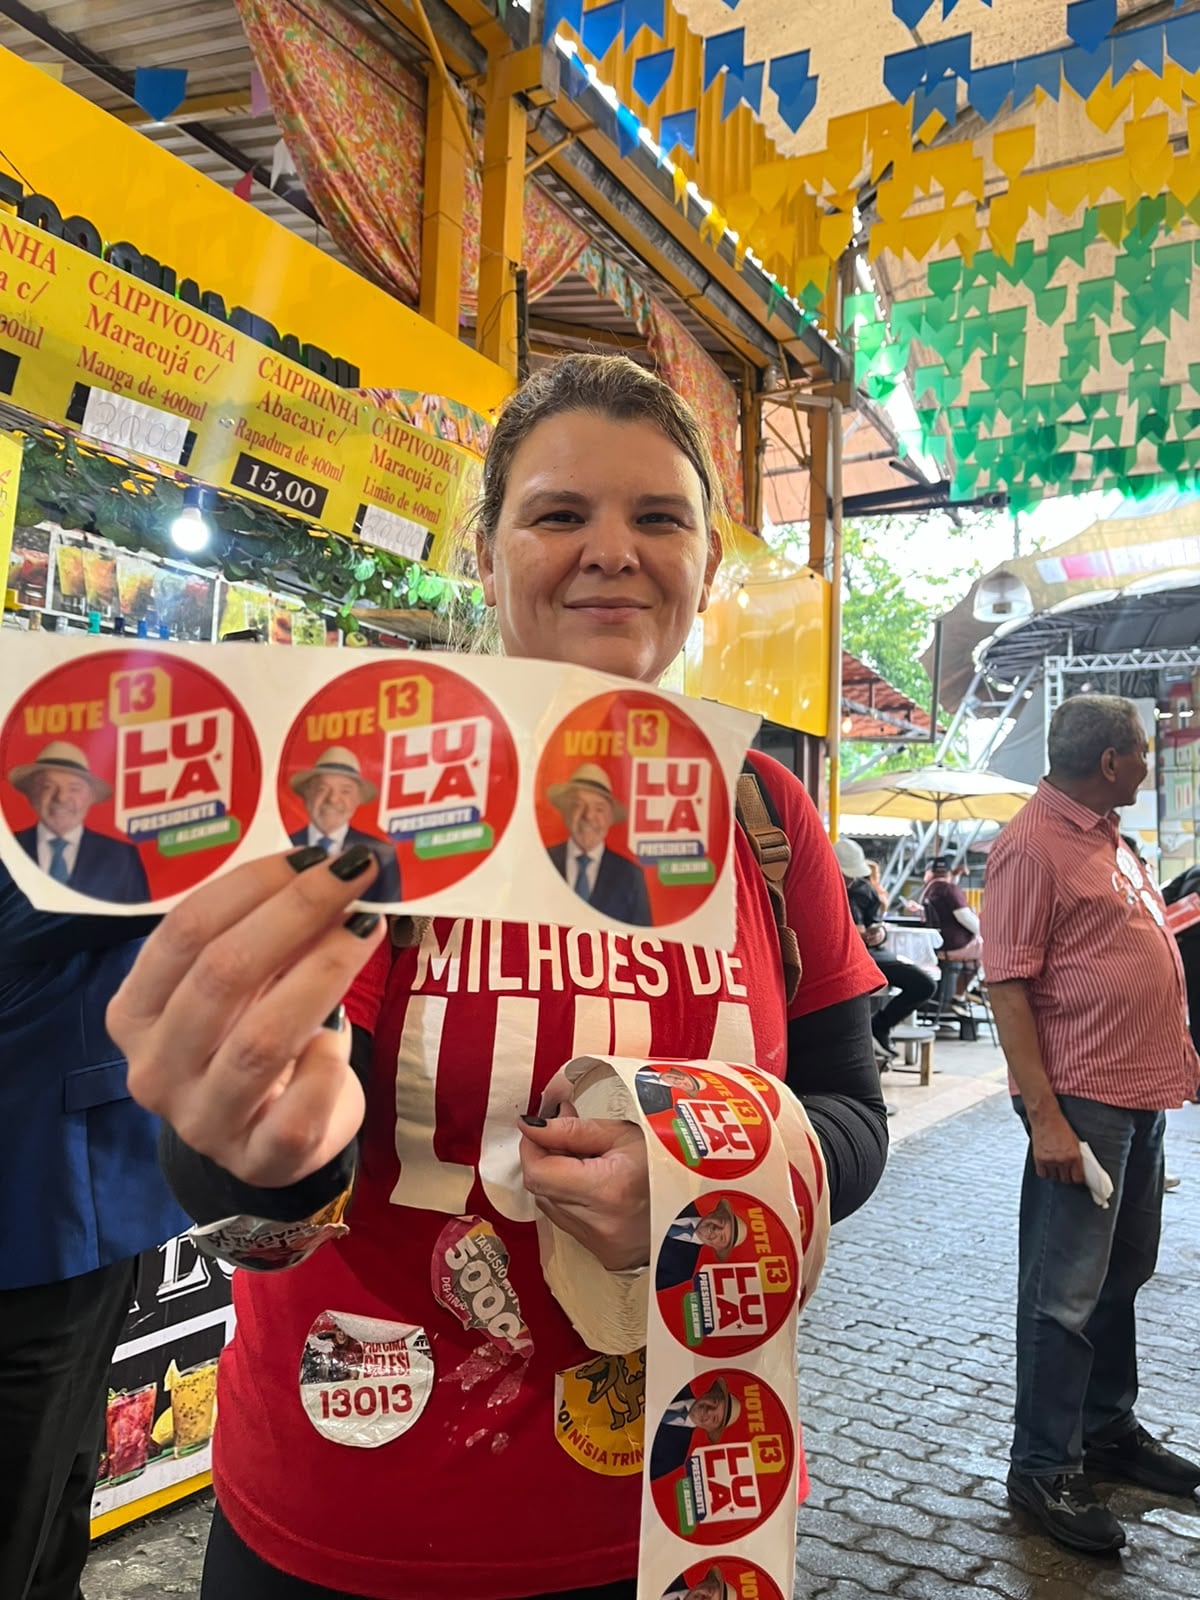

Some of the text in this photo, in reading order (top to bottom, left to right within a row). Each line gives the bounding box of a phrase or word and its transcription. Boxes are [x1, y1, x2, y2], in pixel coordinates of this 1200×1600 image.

[17, 281, 49, 304] c/
[89, 270, 236, 363] CAIPIVODKA
[86, 303, 220, 384] Maracujá c/
[76, 346, 208, 422] Manga de 400ml
[258, 356, 360, 426] CAIPIRINHA
[256, 391, 347, 446] Abacaxi c/
[234, 418, 345, 482] Rapadura de 400ml
[370, 444, 450, 497] Maracujá c/
[372, 417, 460, 477] CAIPIVODKA
[246, 464, 317, 509] 15,00
[362, 476, 442, 525] Limão de 400ml
[24, 672, 157, 736] VOTE 13
[306, 681, 420, 742] VOTE 13
[563, 713, 659, 757] VOTE 13
[130, 803, 217, 834] PRESIDENTE
[391, 808, 472, 833] PRESIDENTE
[683, 942, 748, 997] DE
[701, 1072, 734, 1098] VOTE
[732, 1101, 757, 1119] 13
[679, 1105, 707, 1152] PRESIDENTE
[748, 1207, 787, 1285] VOTE 13
[698, 1274, 714, 1329] PRESIDENTE
[320, 1383, 413, 1419] 13013
[744, 1383, 782, 1464] VOTE 13
[567, 1428, 608, 1465] NÍSIA
[691, 1457, 706, 1515] PRESIDENTE
